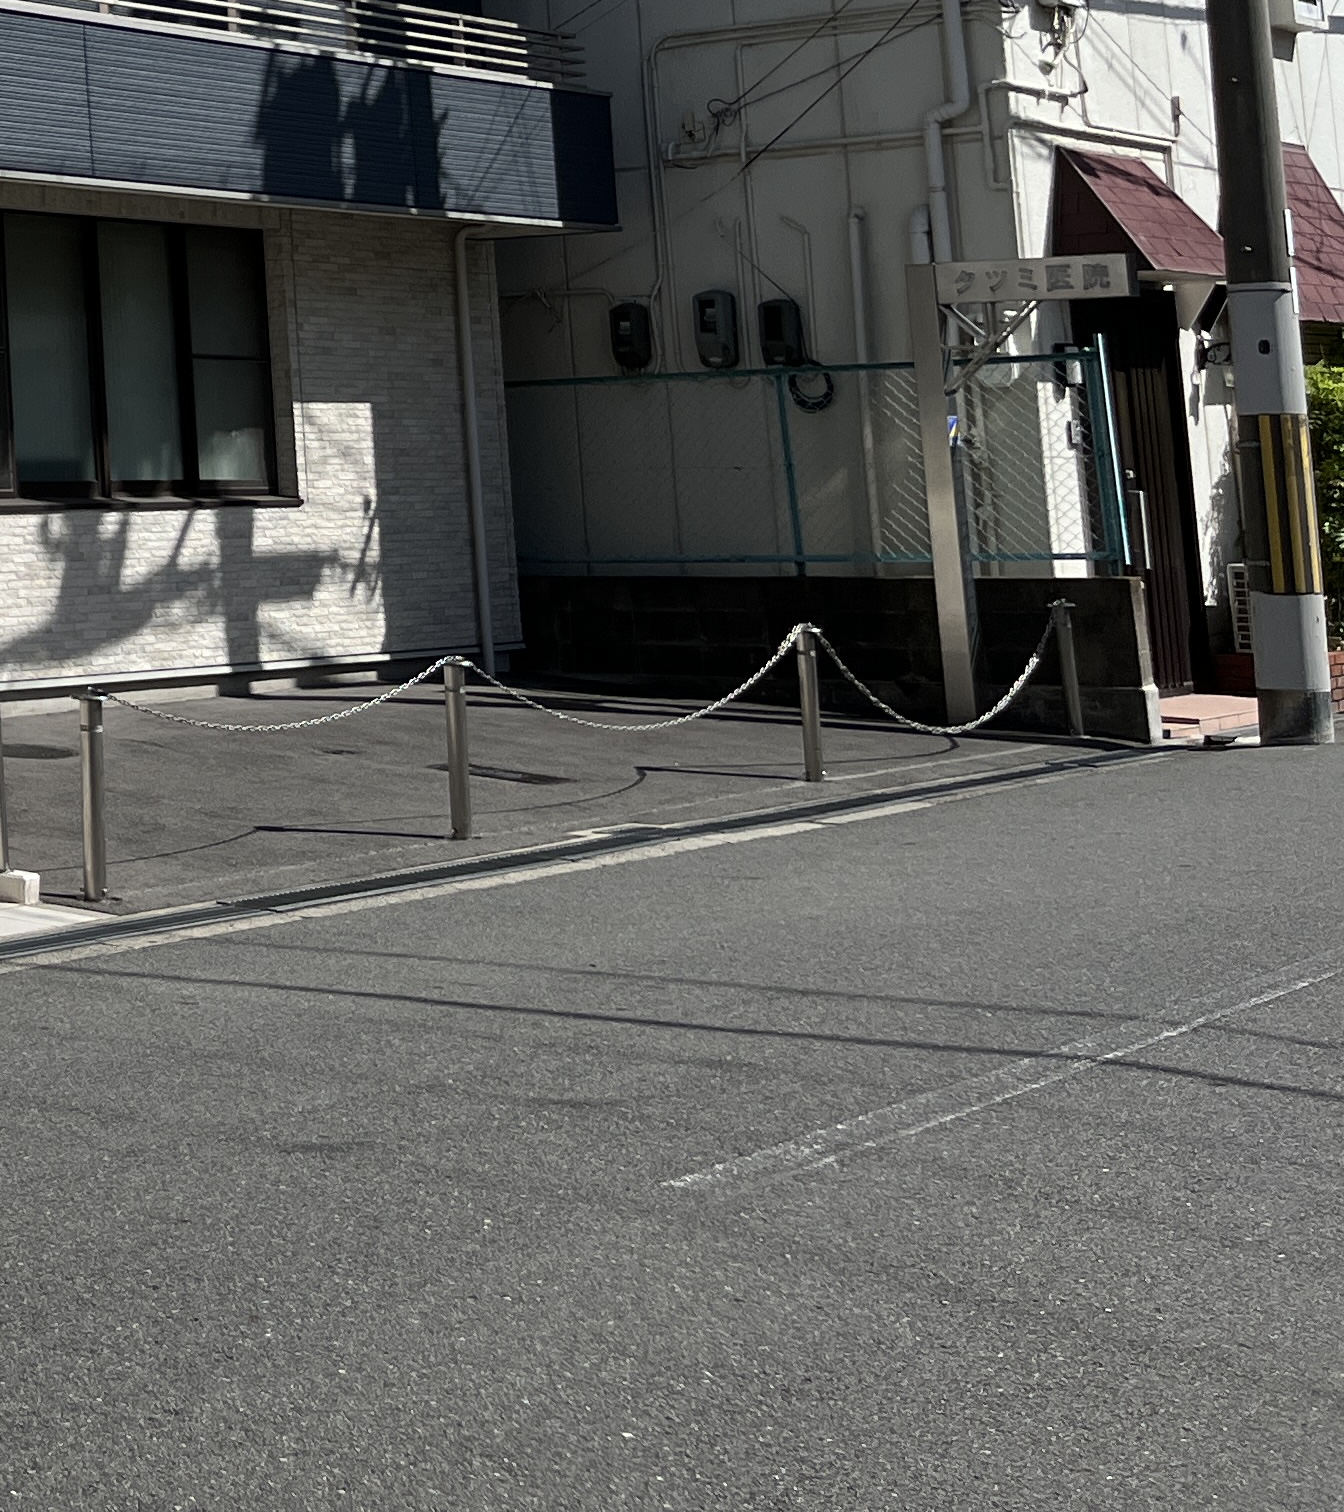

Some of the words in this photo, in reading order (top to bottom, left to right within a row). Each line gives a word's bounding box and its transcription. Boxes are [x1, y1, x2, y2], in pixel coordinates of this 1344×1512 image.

[954, 263, 1111, 296] タツミ医院
